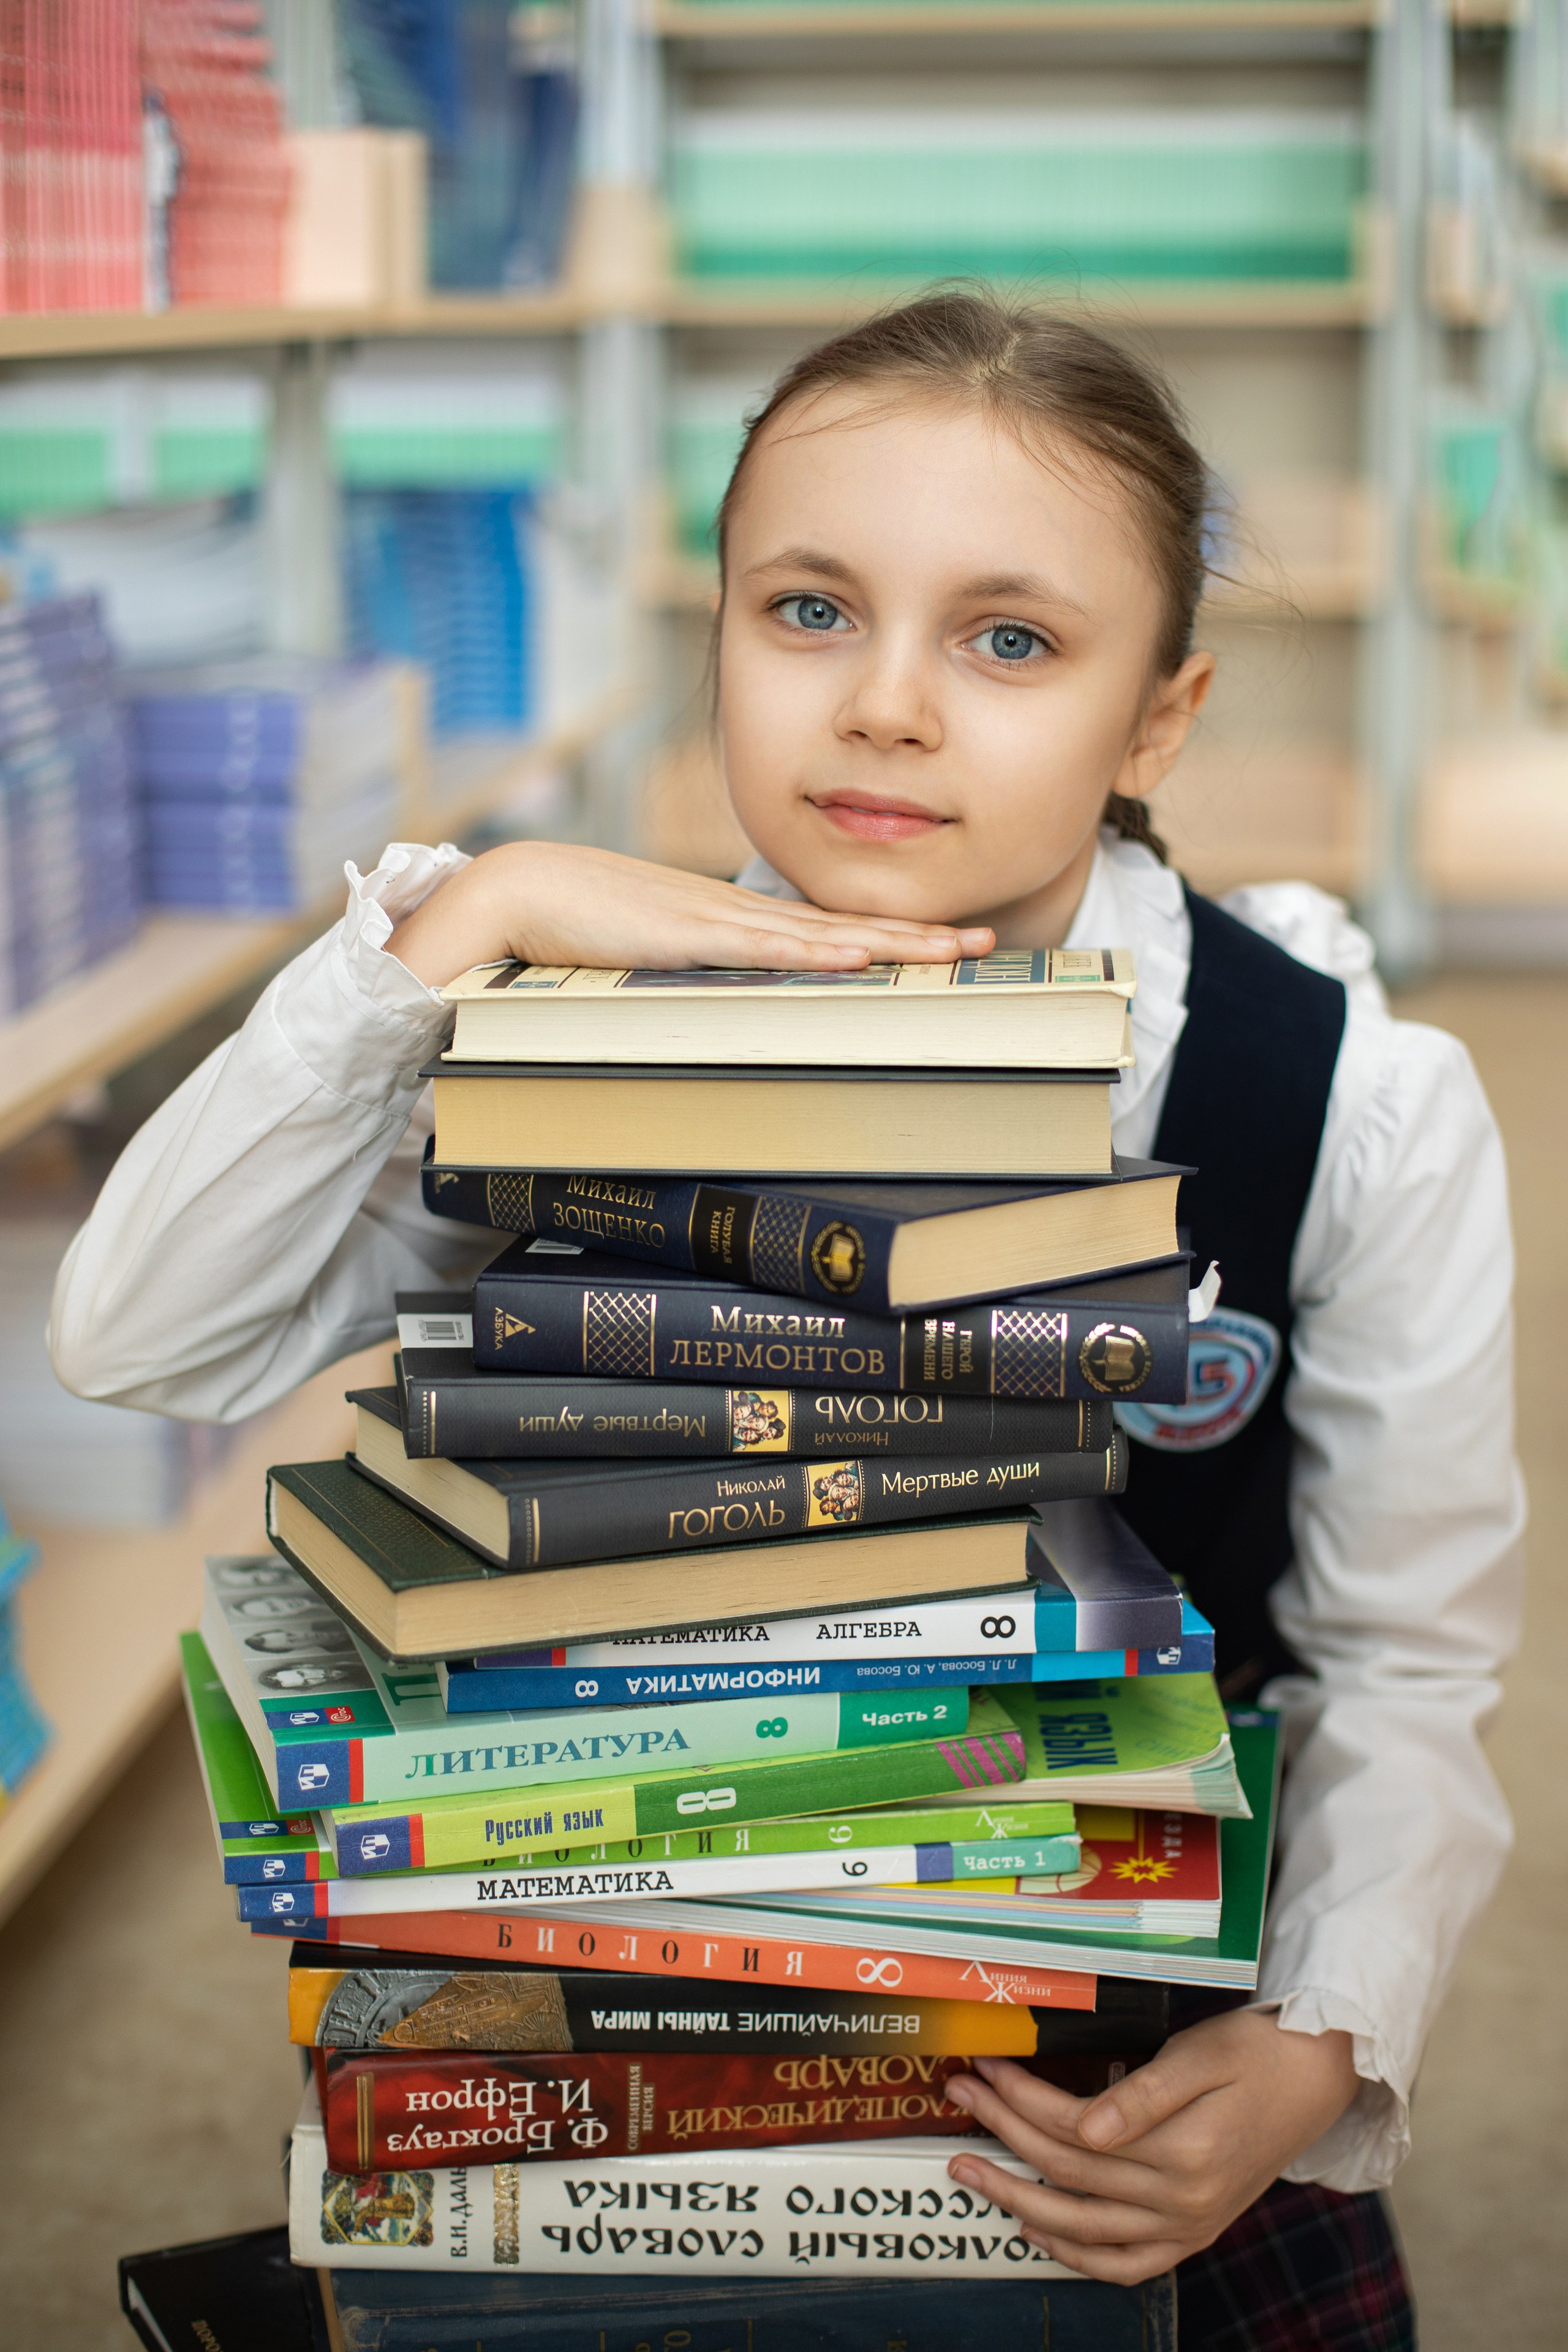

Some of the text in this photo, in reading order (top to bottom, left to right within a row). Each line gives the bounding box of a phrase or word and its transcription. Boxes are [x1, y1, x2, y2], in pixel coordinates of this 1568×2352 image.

[567, 1175, 657, 1209] Михаил
[553, 1202, 666, 1248] ЗОЩЕНКО
[710, 1210, 722, 1254] КНИГА
[722, 1206, 735, 1264] ГОЛУБАЯ
[494, 1307, 503, 1350] АЗБУКА
[710, 1305, 845, 1338] Михаил
[670, 1340, 885, 1374] ЛЕРМОНТОВ
[924, 1318, 937, 1381] ВРЕМЕНИ
[941, 1321, 955, 1380] НАШЕГО
[959, 1330, 973, 1373] ГЕРОЙ
[520, 1406, 706, 1438] Мертвые души
[815, 1395, 943, 1423] ГОГОЛЬ
[815, 1432, 888, 1446] Николай
[717, 1475, 786, 1497] Николай
[881, 1462, 1039, 1498] Мертвые души
[669, 1499, 785, 1538] ГОГОЛЬ
[816, 1621, 922, 1640] АЛГЕБРА
[980, 1615, 1016, 1638] 8
[575, 1667, 820, 1697] ИНФОРМАТИКА 8
[857, 1659, 1017, 1676] Л. Л. Босова, А. Ю. Босова
[862, 1705, 948, 1726] Часть 2
[405, 1717, 788, 1779] ЛИТЕРАТУРА 8
[1039, 1713, 1118, 1770] ЯЗЫК
[485, 1787, 736, 1845] Русский язык 8
[1035, 1851, 1046, 1866] 1
[477, 1871, 674, 1900] МАТЕМАТИКА
[497, 1923, 903, 1987] БИОЛОГИЯ 8
[590, 2010, 919, 2037] ВЕЛИЧАЙШИЕ ТАЙНЫ МИРА
[405, 2078, 594, 2121] И. Ефрон
[627, 2065, 641, 2151] СОВРЕМЕННАЯ
[643, 2086, 654, 2132] ВЕРСИЯ
[386, 2117, 609, 2154] Ф. Брокгауз
